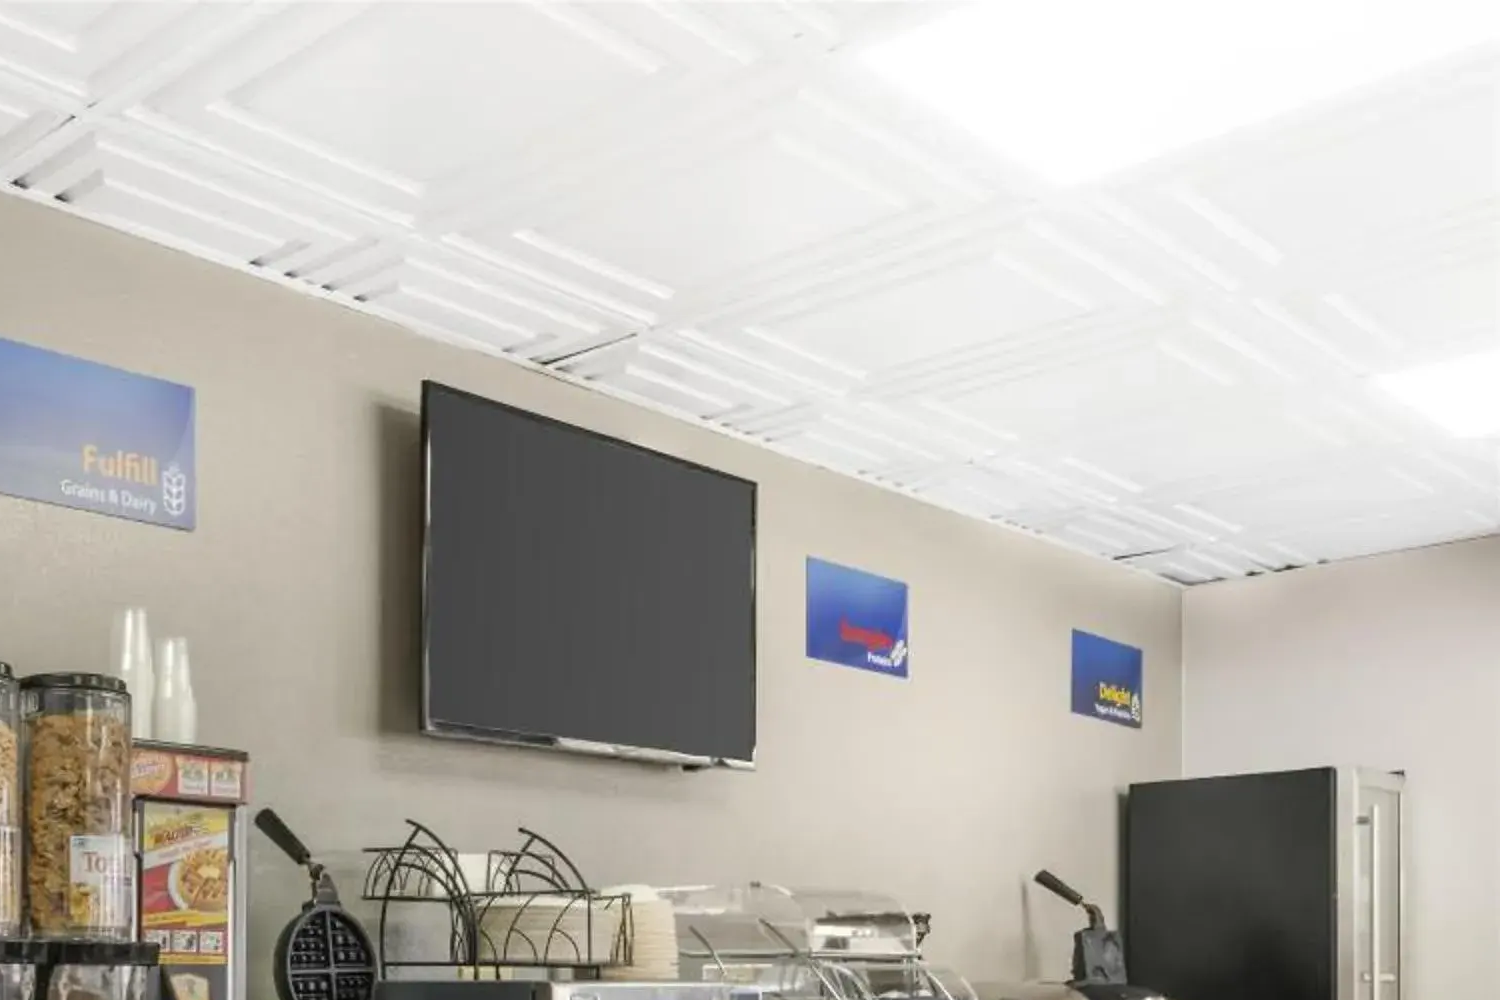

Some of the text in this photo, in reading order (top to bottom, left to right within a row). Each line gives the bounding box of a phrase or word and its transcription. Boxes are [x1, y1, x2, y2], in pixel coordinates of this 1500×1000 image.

[82, 444, 158, 486] Fulfill
[60, 479, 105, 503] Grains
[121, 490, 158, 516] Dairy
